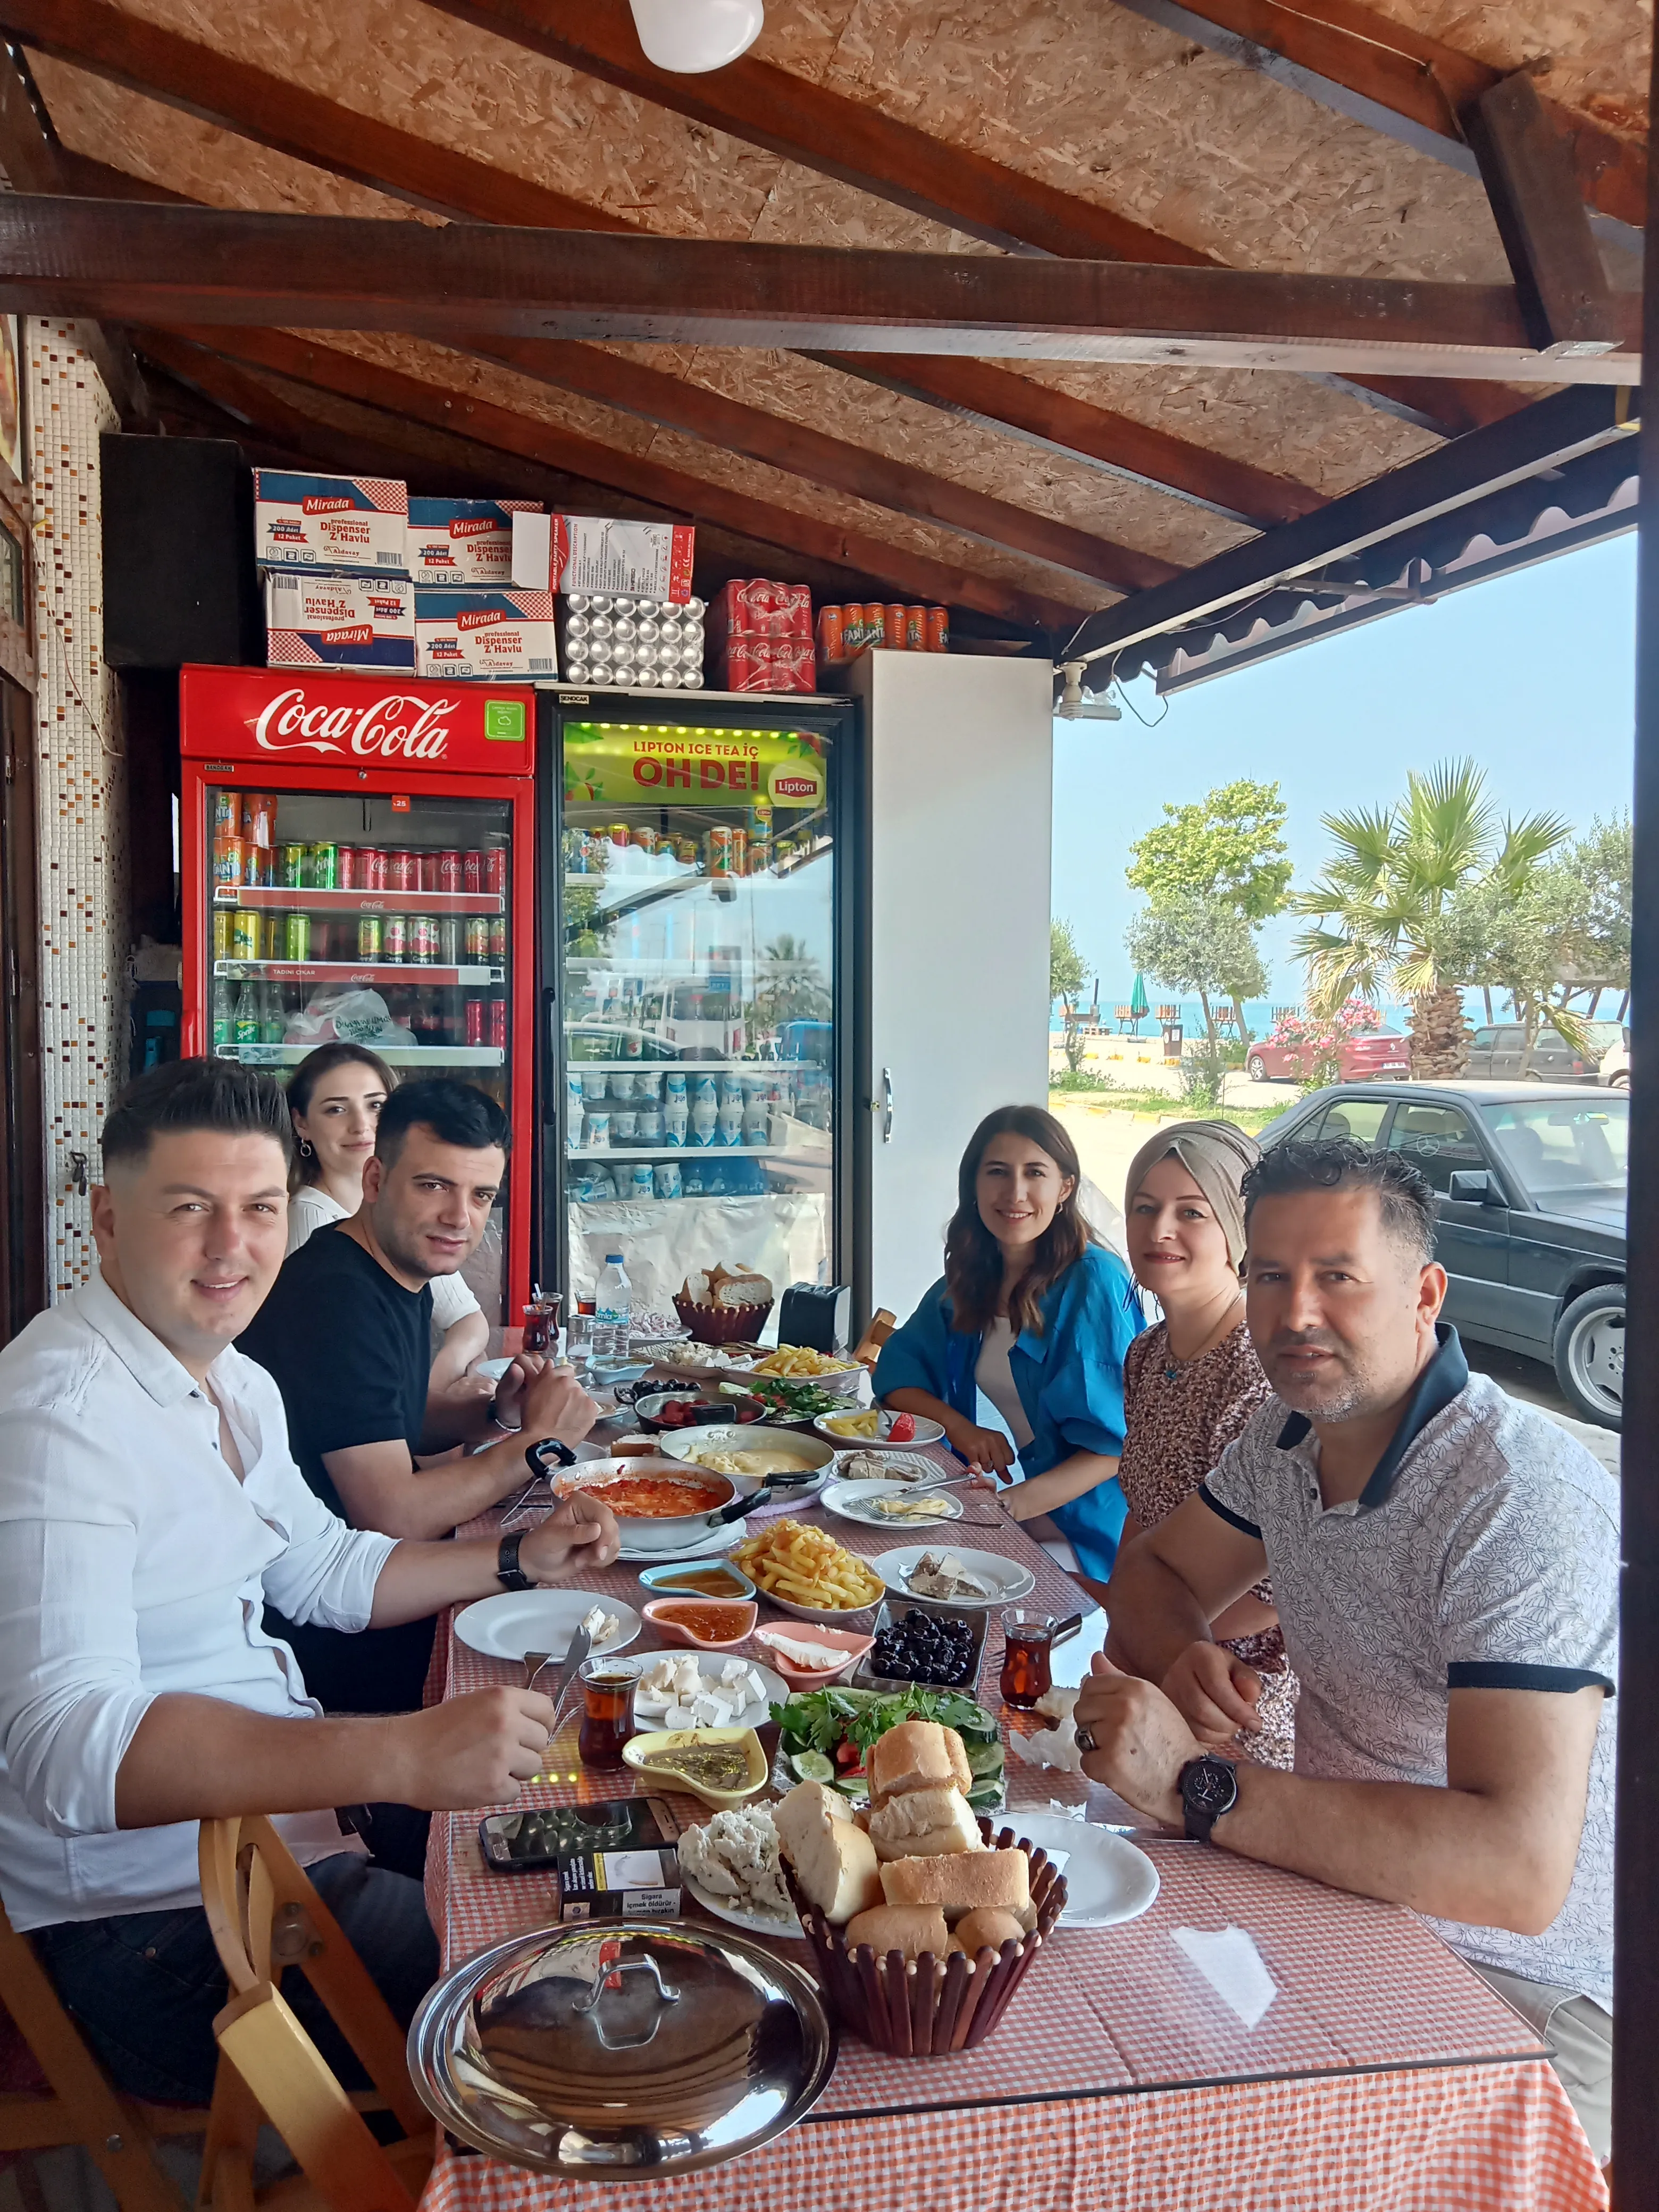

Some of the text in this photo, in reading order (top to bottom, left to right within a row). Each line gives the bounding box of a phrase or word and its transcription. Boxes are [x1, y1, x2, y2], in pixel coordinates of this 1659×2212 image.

[306, 499, 349, 512] Mirada
[320, 522, 371, 534] Dispenser
[453, 521, 493, 535] Mirada
[341, 533, 370, 543] Havlu
[305, 598, 335, 607] Havlu
[304, 606, 355, 618] Dispenser
[461, 612, 501, 627] Mirada
[326, 628, 369, 642] Mirada
[475, 636, 522, 646] Dispenser
[256, 689, 462, 759] Coca-Cola
[634, 741, 759, 760] LIPTON ICE TEA İÇ
[633, 756, 759, 791] OH DE!
[778, 781, 814, 793] Lipton
[237, 1025, 256, 1040] Sprite
